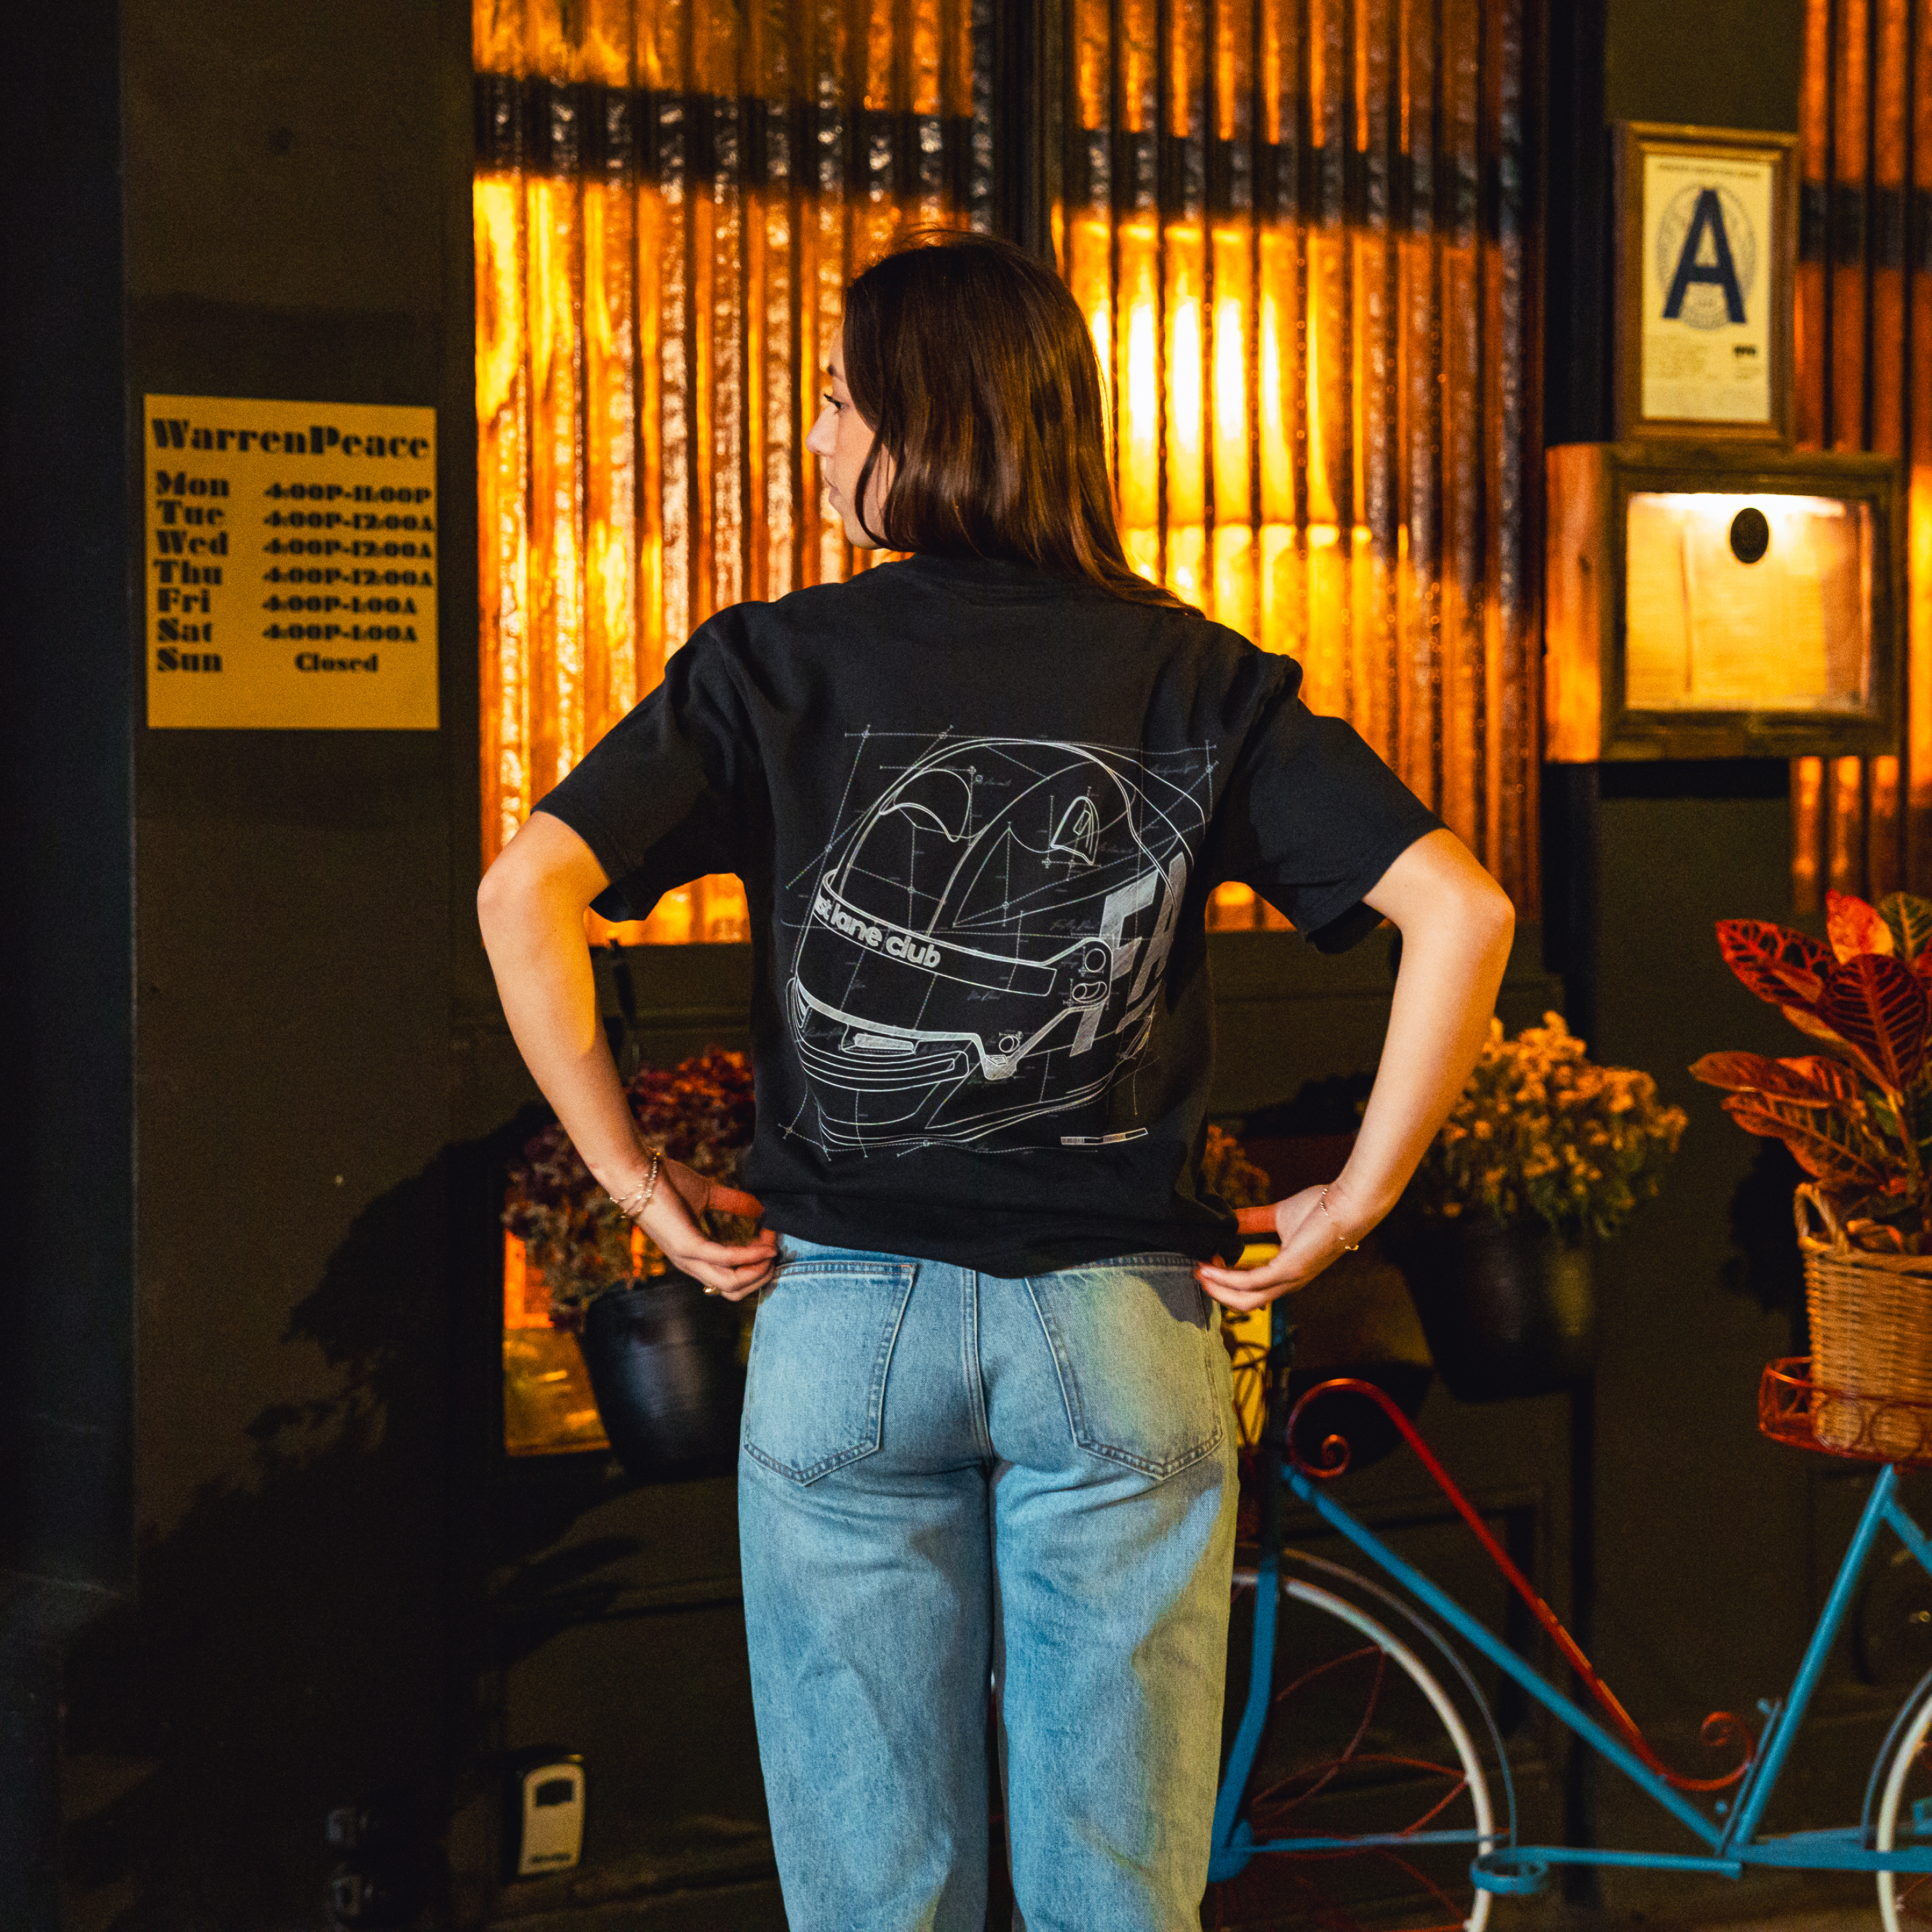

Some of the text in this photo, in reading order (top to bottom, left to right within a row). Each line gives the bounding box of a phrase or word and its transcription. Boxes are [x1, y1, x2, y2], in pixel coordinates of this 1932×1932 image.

[1662, 189, 1747, 324] A
[155, 471, 230, 497] Mon
[155, 499, 225, 526] Tue
[155, 529, 229, 556] Wed
[153, 559, 223, 585] Thu
[157, 587, 211, 614] Fri
[157, 618, 213, 643] Sat
[156, 647, 379, 673] Sun Closed
[830, 903, 882, 947] lane
[886, 935, 941, 968] club
